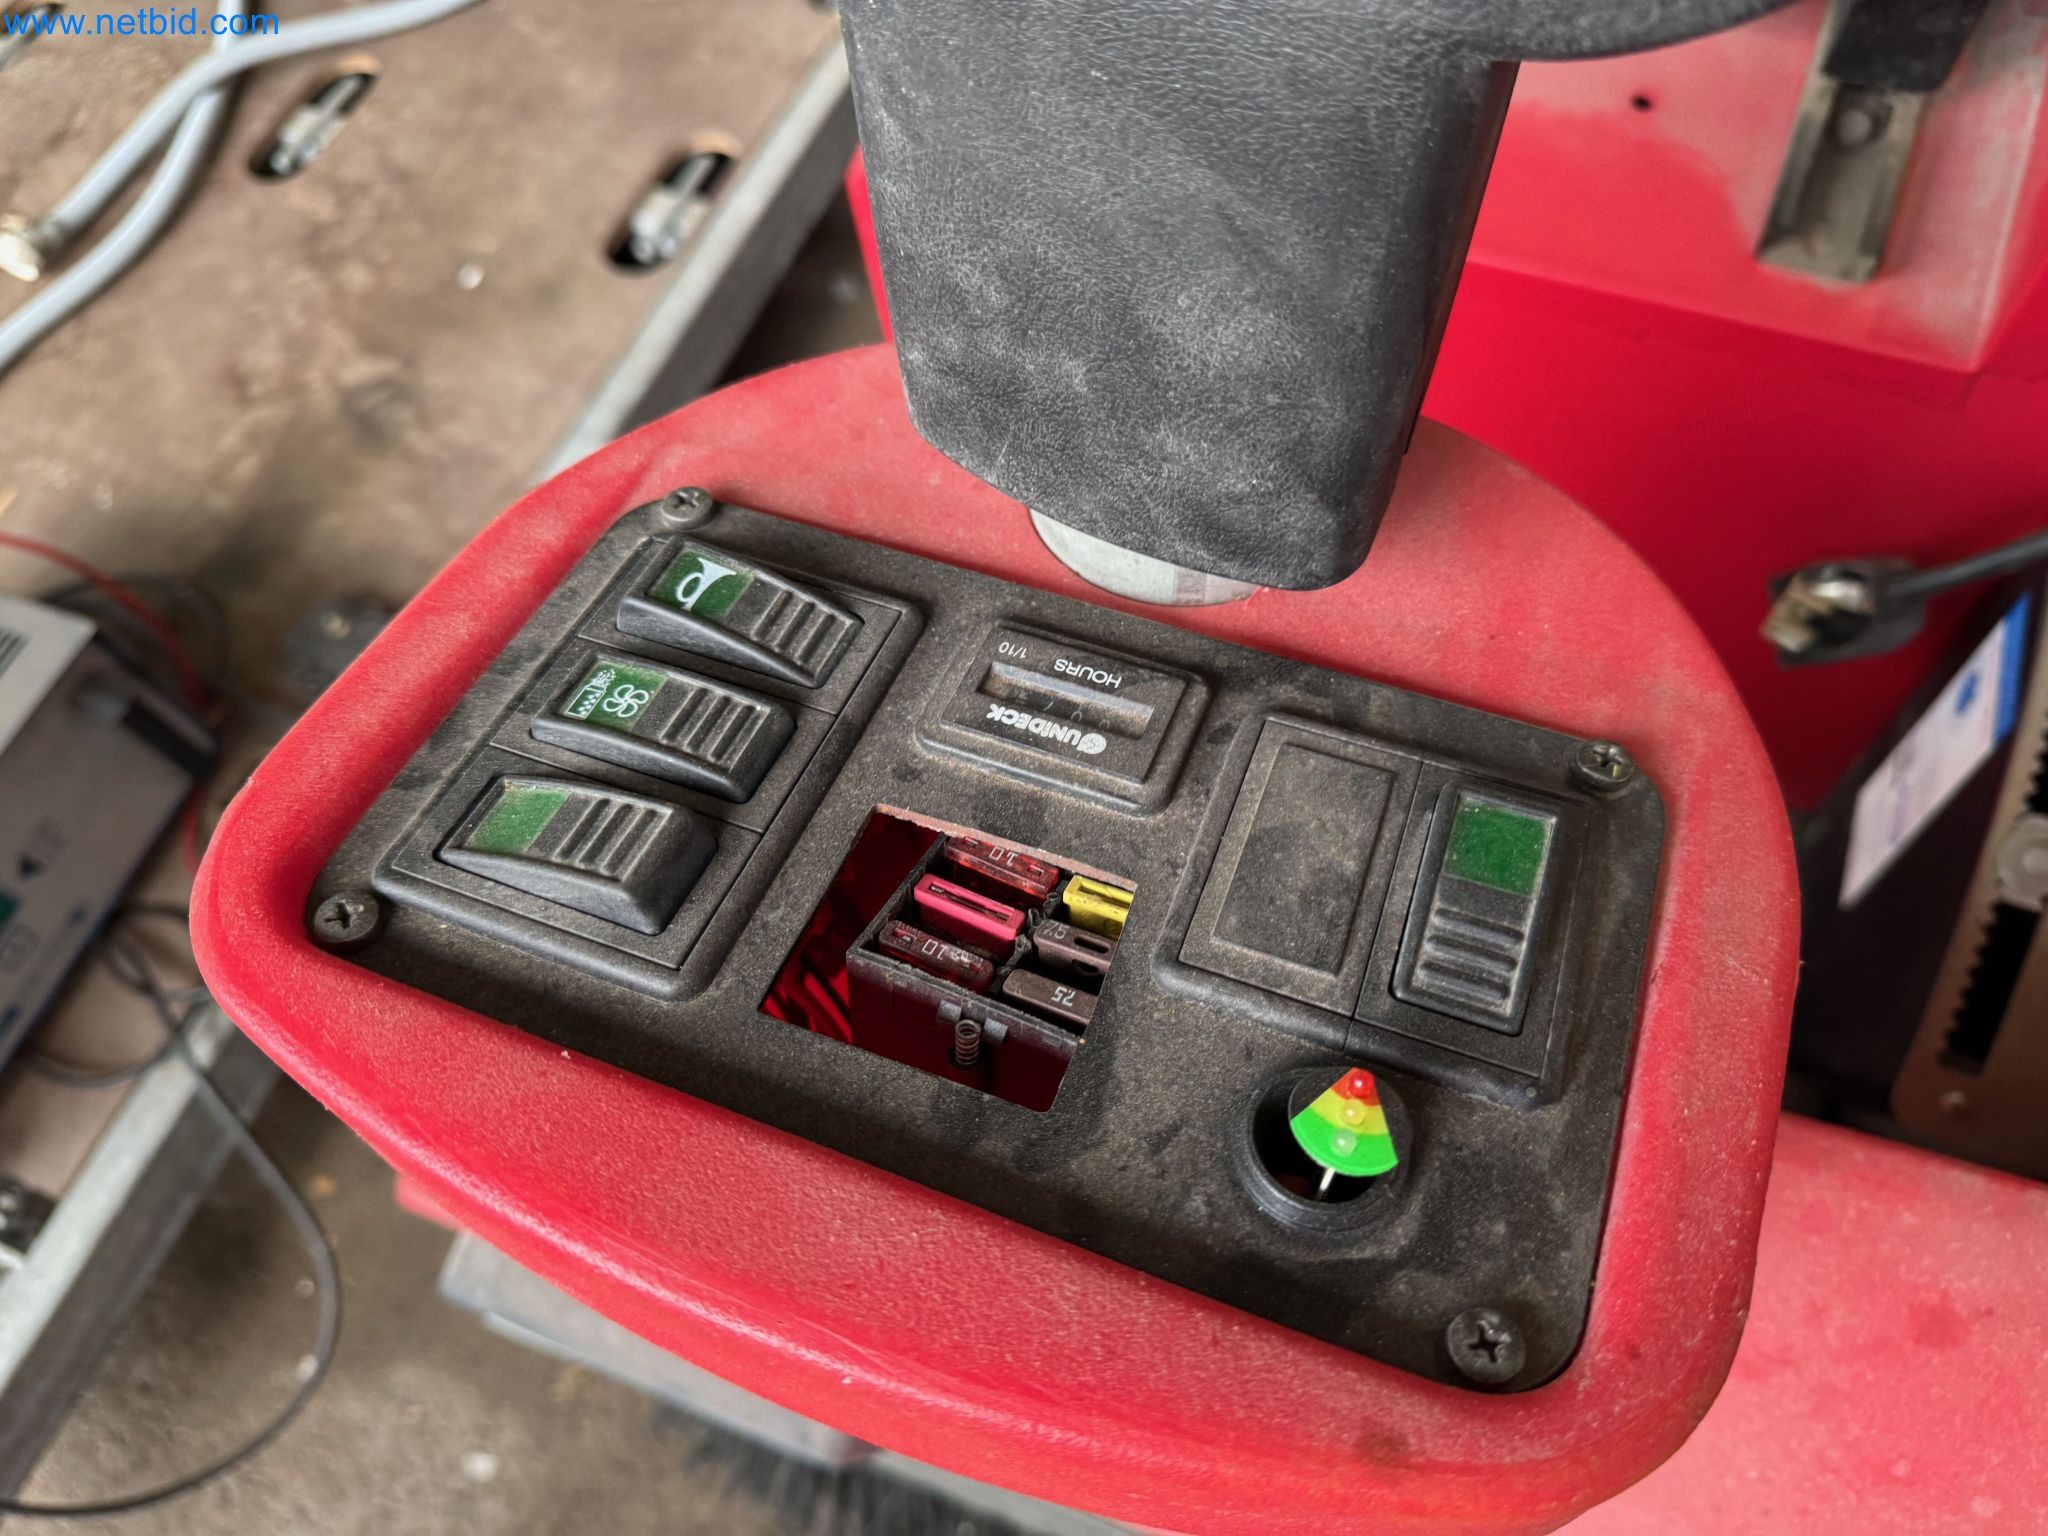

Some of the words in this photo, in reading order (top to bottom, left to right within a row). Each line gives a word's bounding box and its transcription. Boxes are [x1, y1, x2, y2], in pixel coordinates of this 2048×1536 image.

[999, 641, 1028, 659] 1/10
[1053, 658, 1122, 688] HOURS
[986, 704, 1084, 749] UNIDECK
[989, 846, 1018, 865] 10
[922, 938, 948, 960] 10
